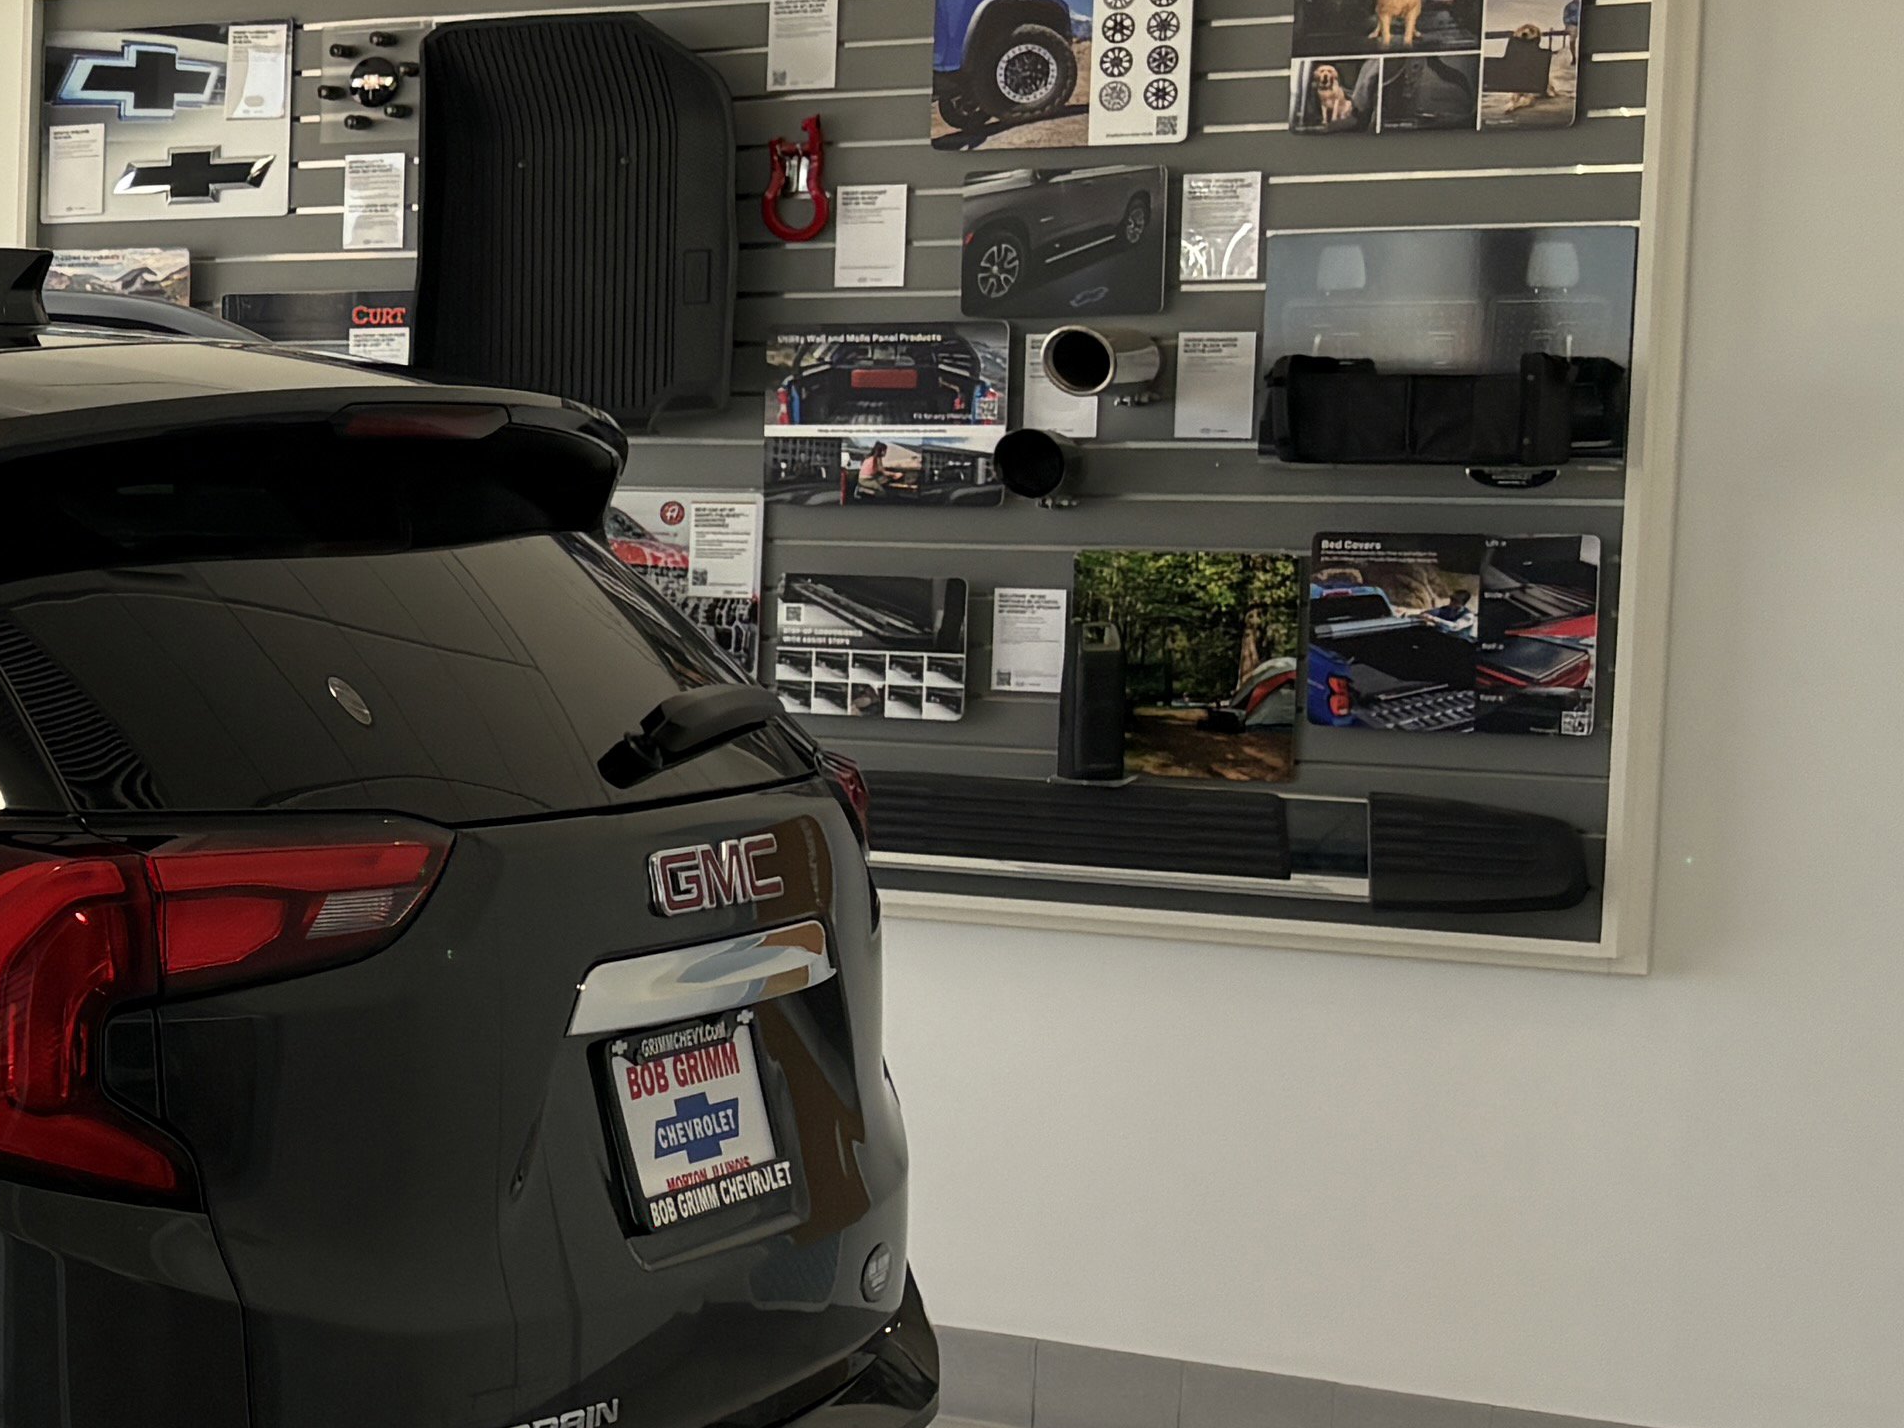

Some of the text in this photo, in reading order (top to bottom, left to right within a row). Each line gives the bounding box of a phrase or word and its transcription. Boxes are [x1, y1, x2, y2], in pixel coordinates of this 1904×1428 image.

[827, 334, 844, 343] and
[872, 333, 898, 343] Panel
[899, 333, 942, 342] Products
[648, 832, 785, 917] GMC
[626, 1041, 741, 1101] BOB GRIMM
[657, 1108, 736, 1149] CHEVROLET
[649, 1161, 792, 1228] BOB GRIMM CHEVROLET
